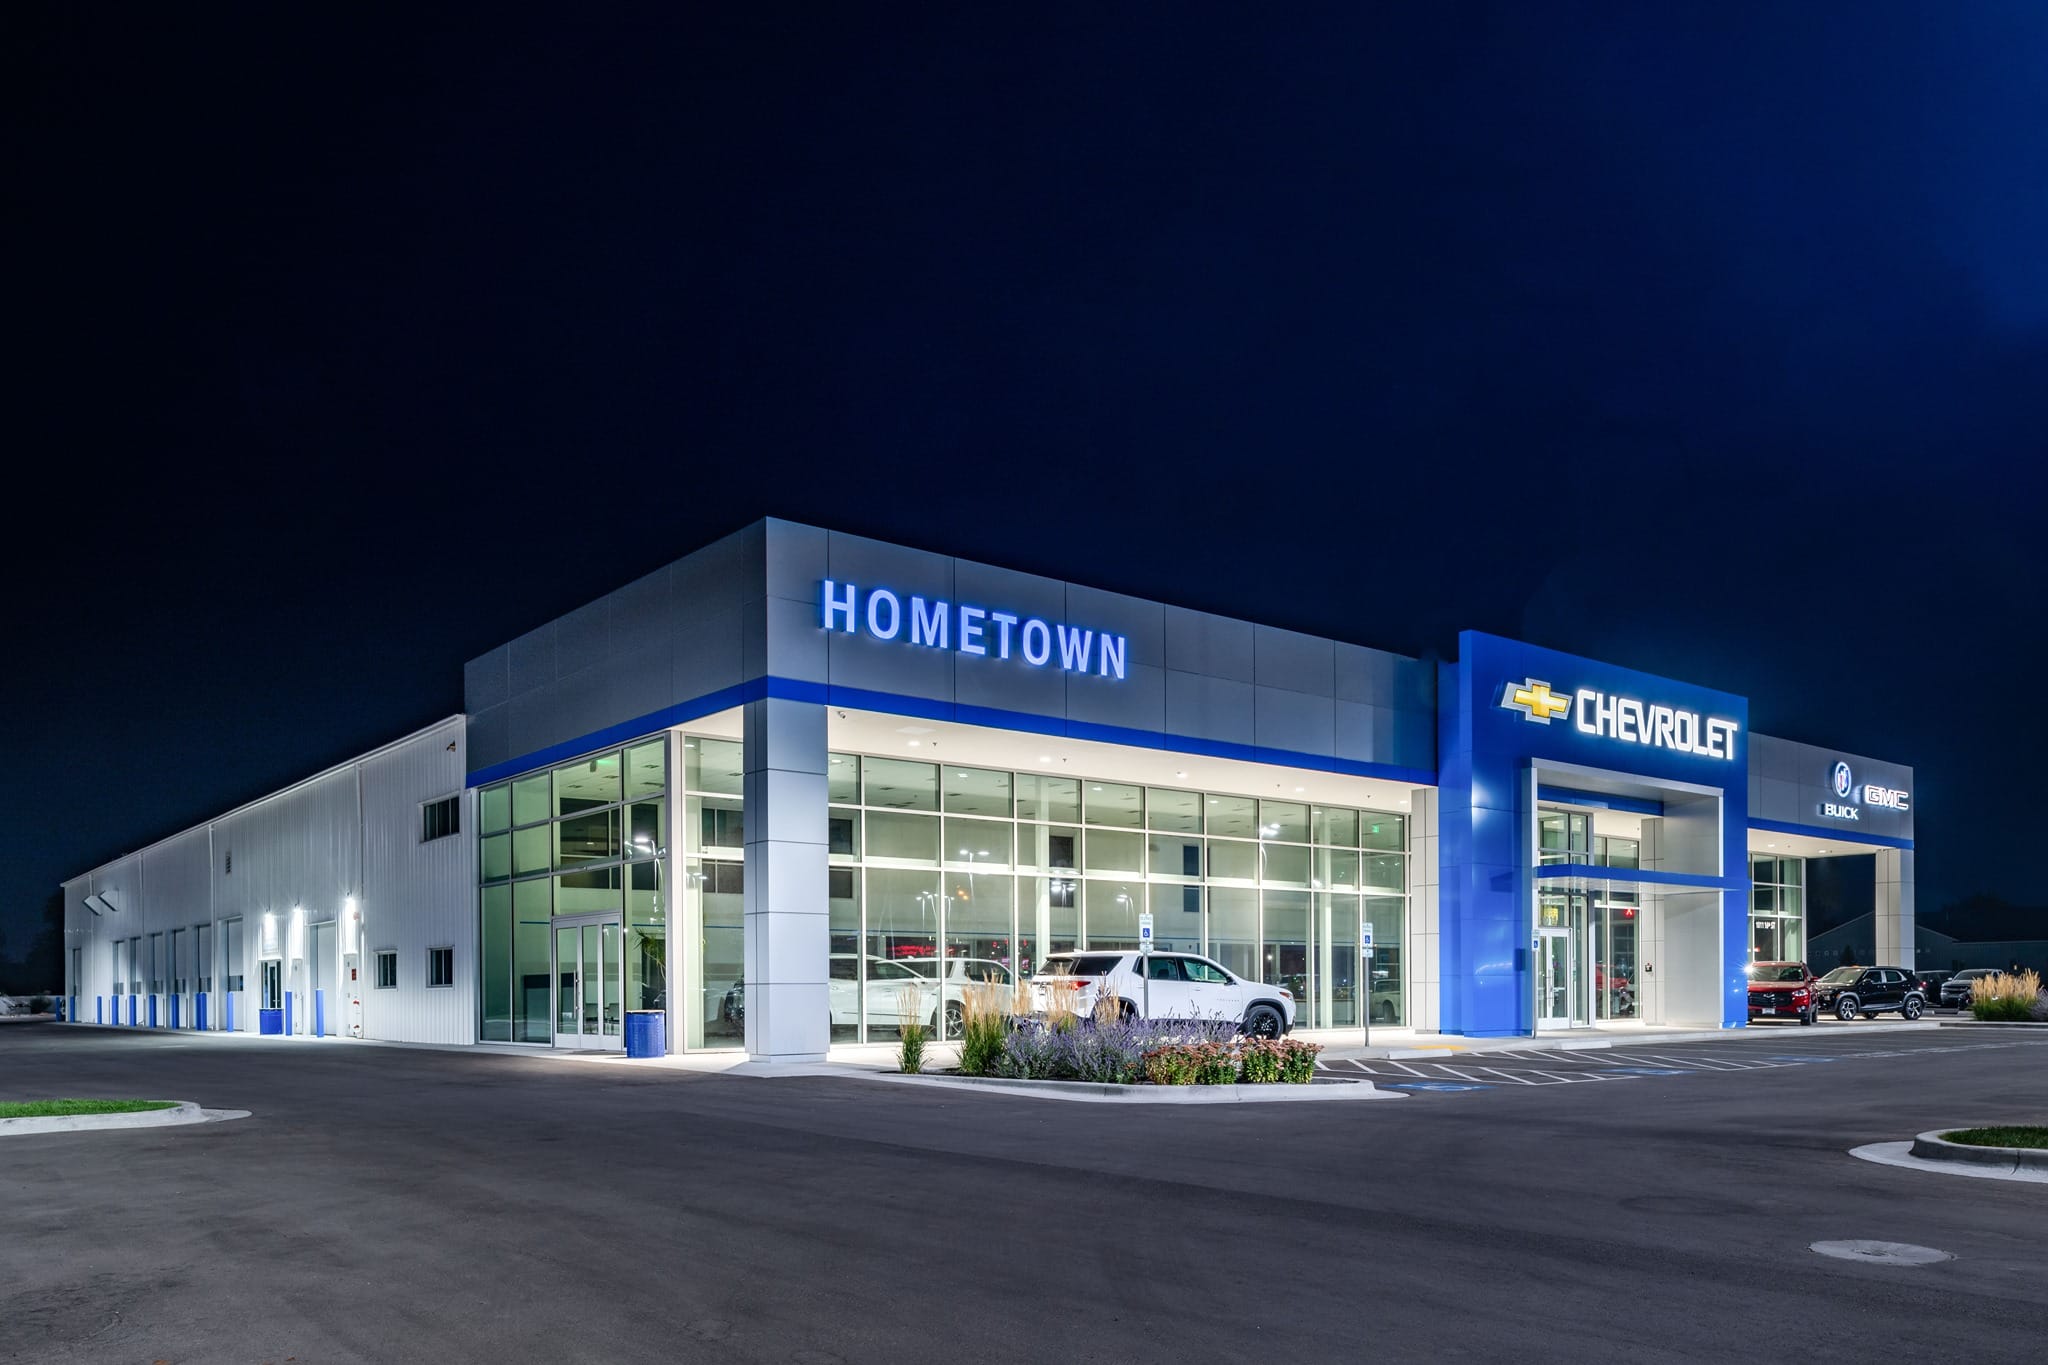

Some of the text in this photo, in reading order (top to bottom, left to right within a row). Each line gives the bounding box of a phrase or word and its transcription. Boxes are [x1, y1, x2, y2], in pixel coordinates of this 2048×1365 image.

[823, 580, 1126, 679] HOMETOWN
[1576, 688, 1738, 760] CHEVROLET
[1825, 803, 1859, 820] BUICK
[1865, 785, 1909, 810] GMC
